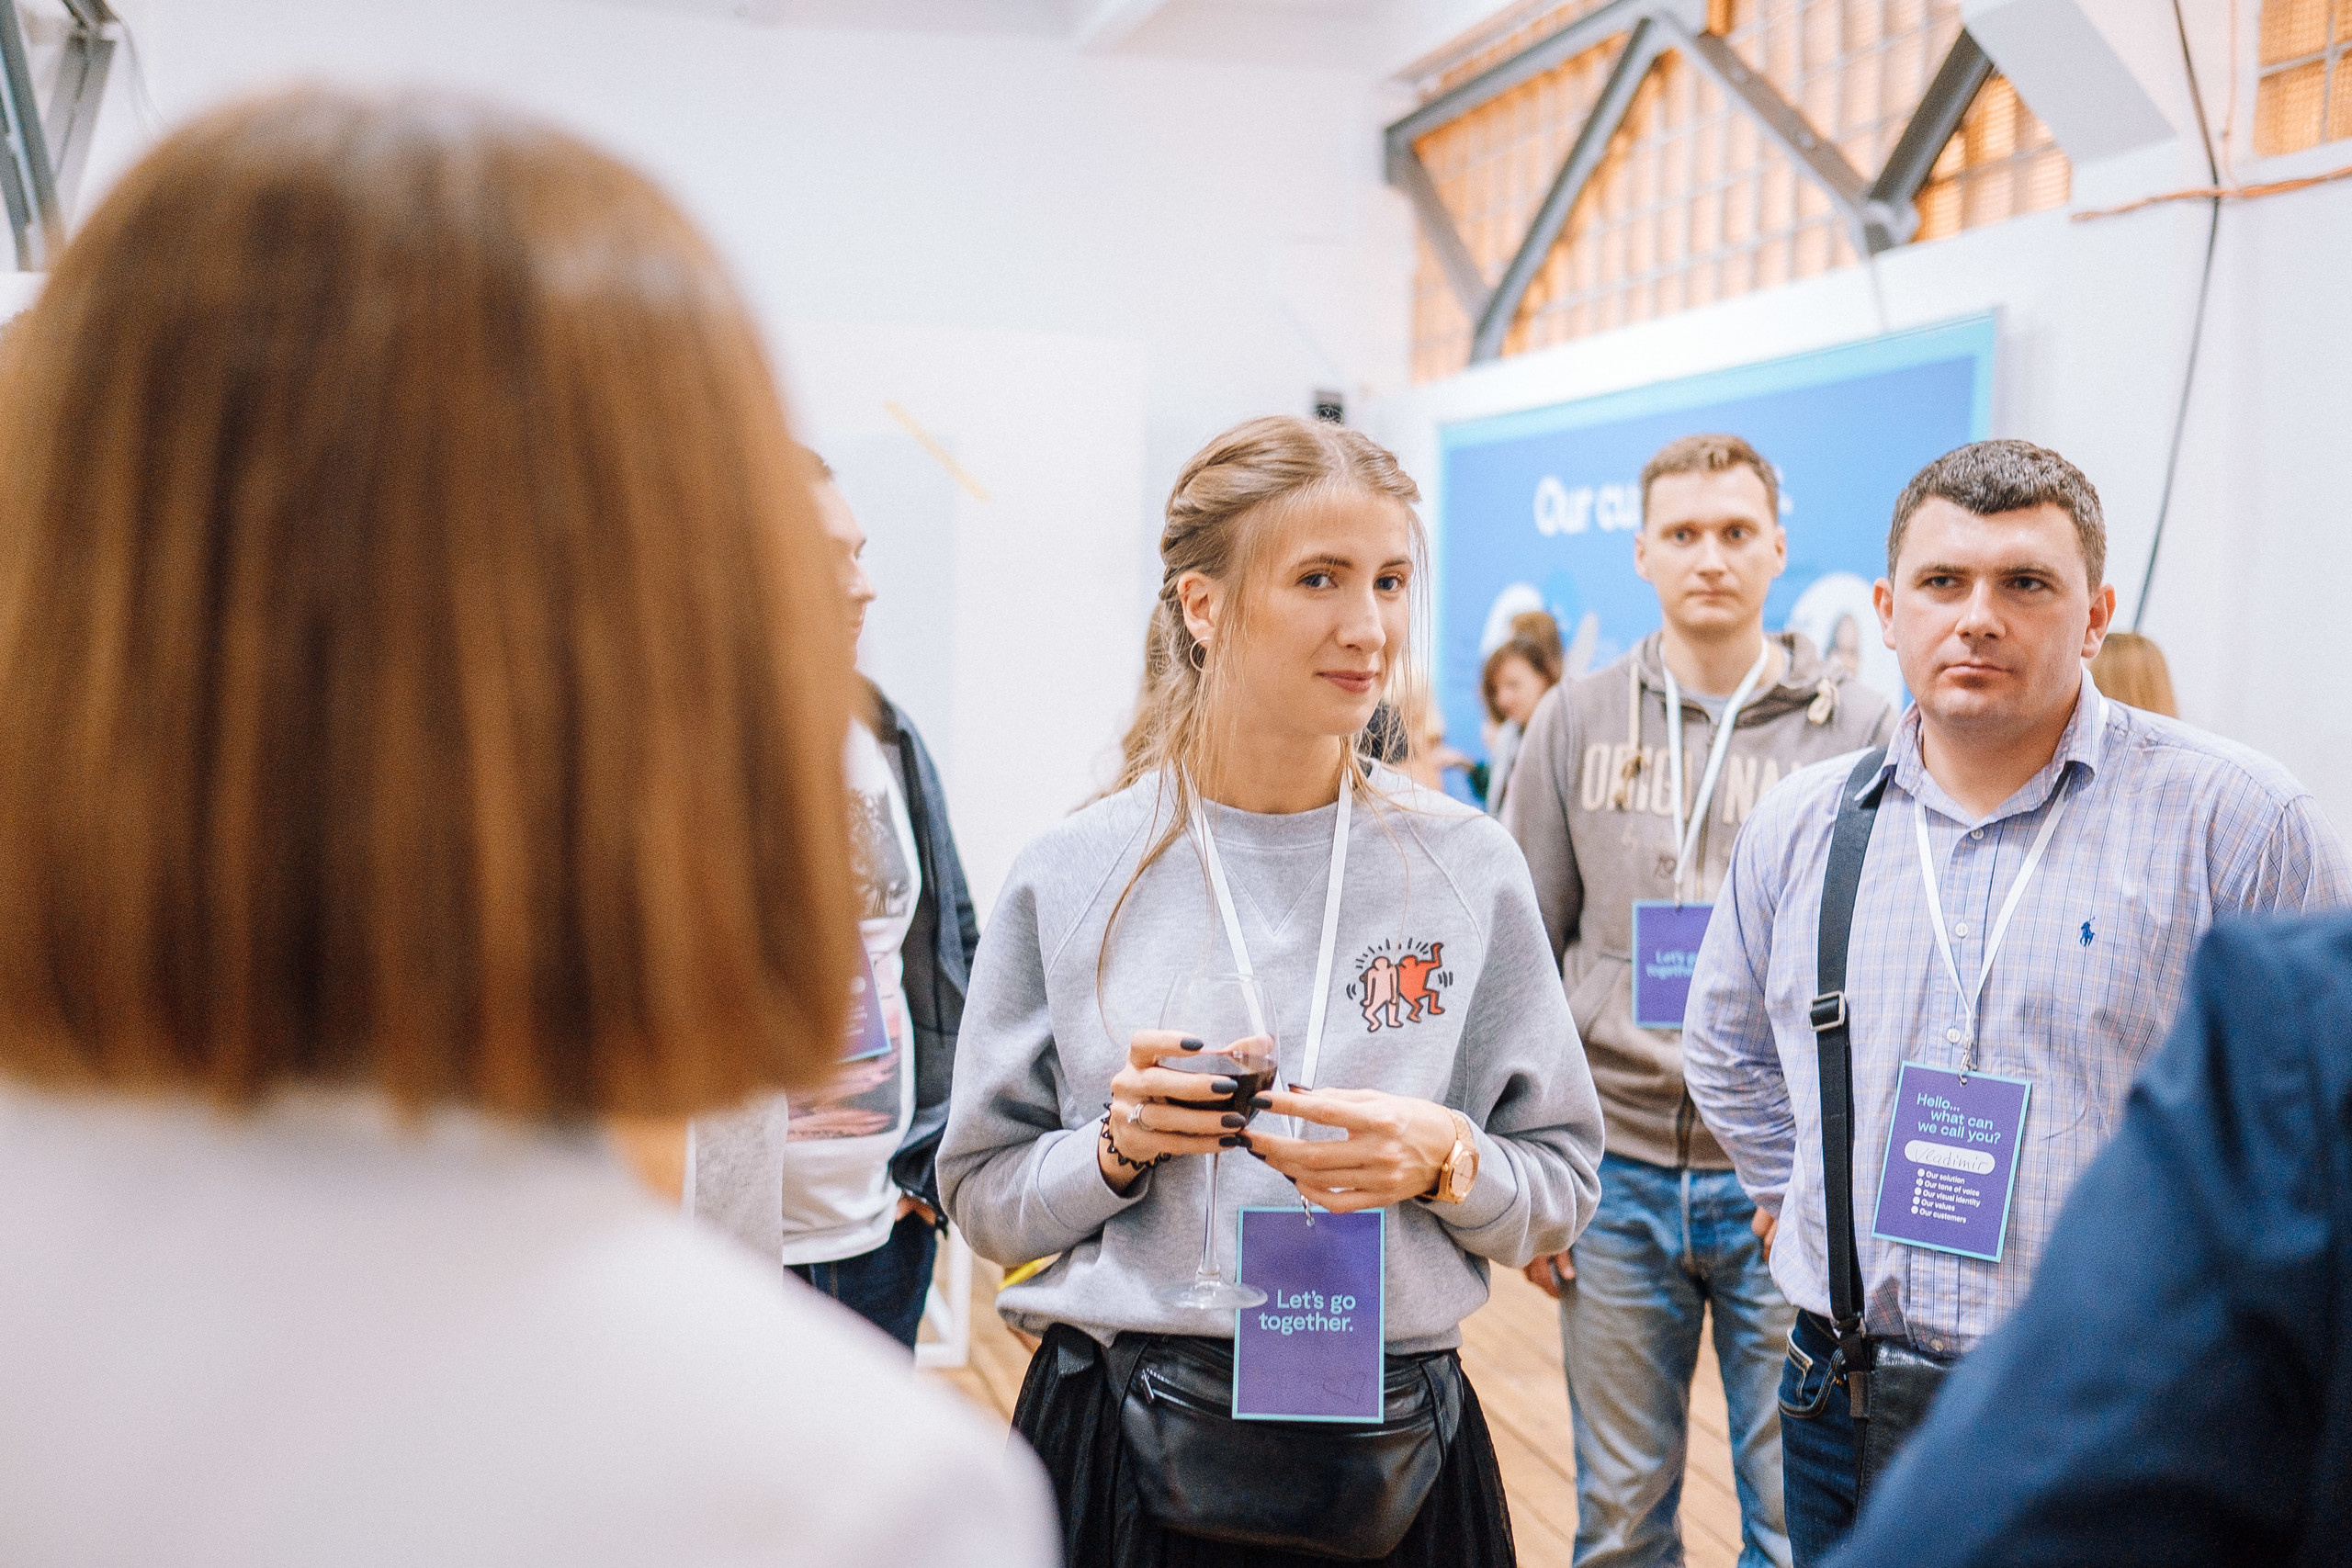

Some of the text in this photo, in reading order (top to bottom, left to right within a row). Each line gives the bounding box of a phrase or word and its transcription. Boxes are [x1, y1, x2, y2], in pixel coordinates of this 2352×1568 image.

[1533, 474, 1593, 536] Our
[1581, 742, 1803, 825] ORIGINA
[1917, 1092, 1961, 1111] Hello...
[1930, 1110, 1994, 1131] what can
[1917, 1121, 2001, 1145] we call you?
[1926, 1170, 1965, 1185] Our solution
[1924, 1179, 1980, 1197] Our tone of voice
[1921, 1198, 1955, 1212] Our values
[1922, 1189, 1981, 1209] Our visual identity
[1919, 1207, 1967, 1224] Our customers
[1277, 1289, 1356, 1315] Let's go
[1258, 1311, 1353, 1336] together.
